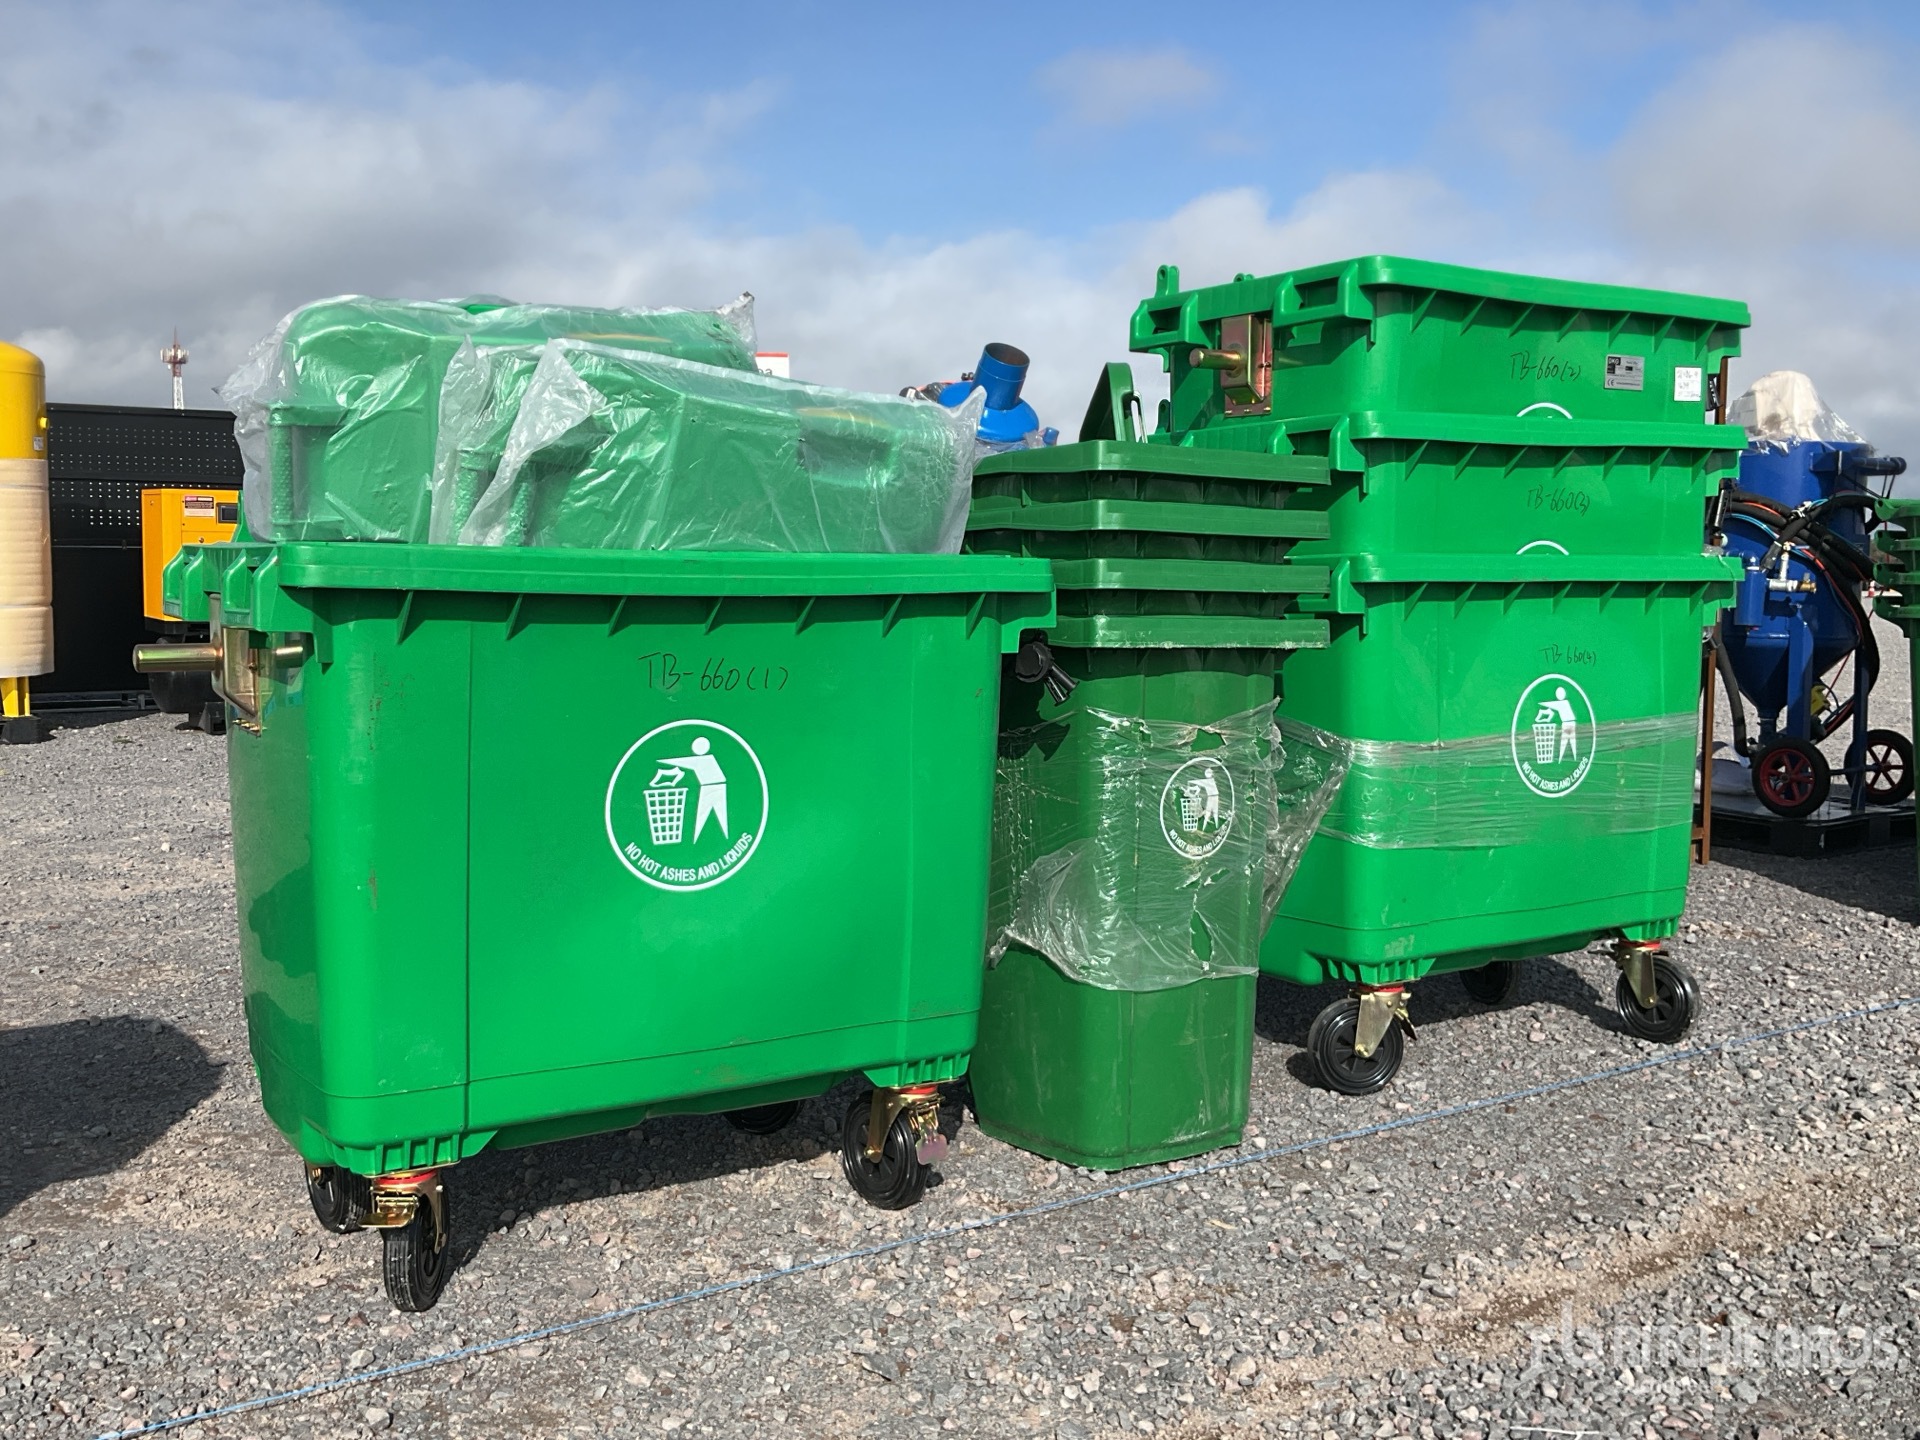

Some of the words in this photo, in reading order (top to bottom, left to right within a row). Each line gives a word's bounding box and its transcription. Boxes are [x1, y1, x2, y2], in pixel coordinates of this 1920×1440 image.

[1521, 761, 1532, 775] NO
[1528, 770, 1542, 786] HOT
[1539, 779, 1559, 791] ASHES
[1559, 777, 1571, 790] AND
[1570, 756, 1588, 783] LIQUIDS
[624, 842, 640, 860] NO
[638, 855, 662, 876] HOT
[659, 866, 697, 882] ASHES
[697, 862, 720, 881] AND
[718, 832, 753, 870] LIQUIDS
